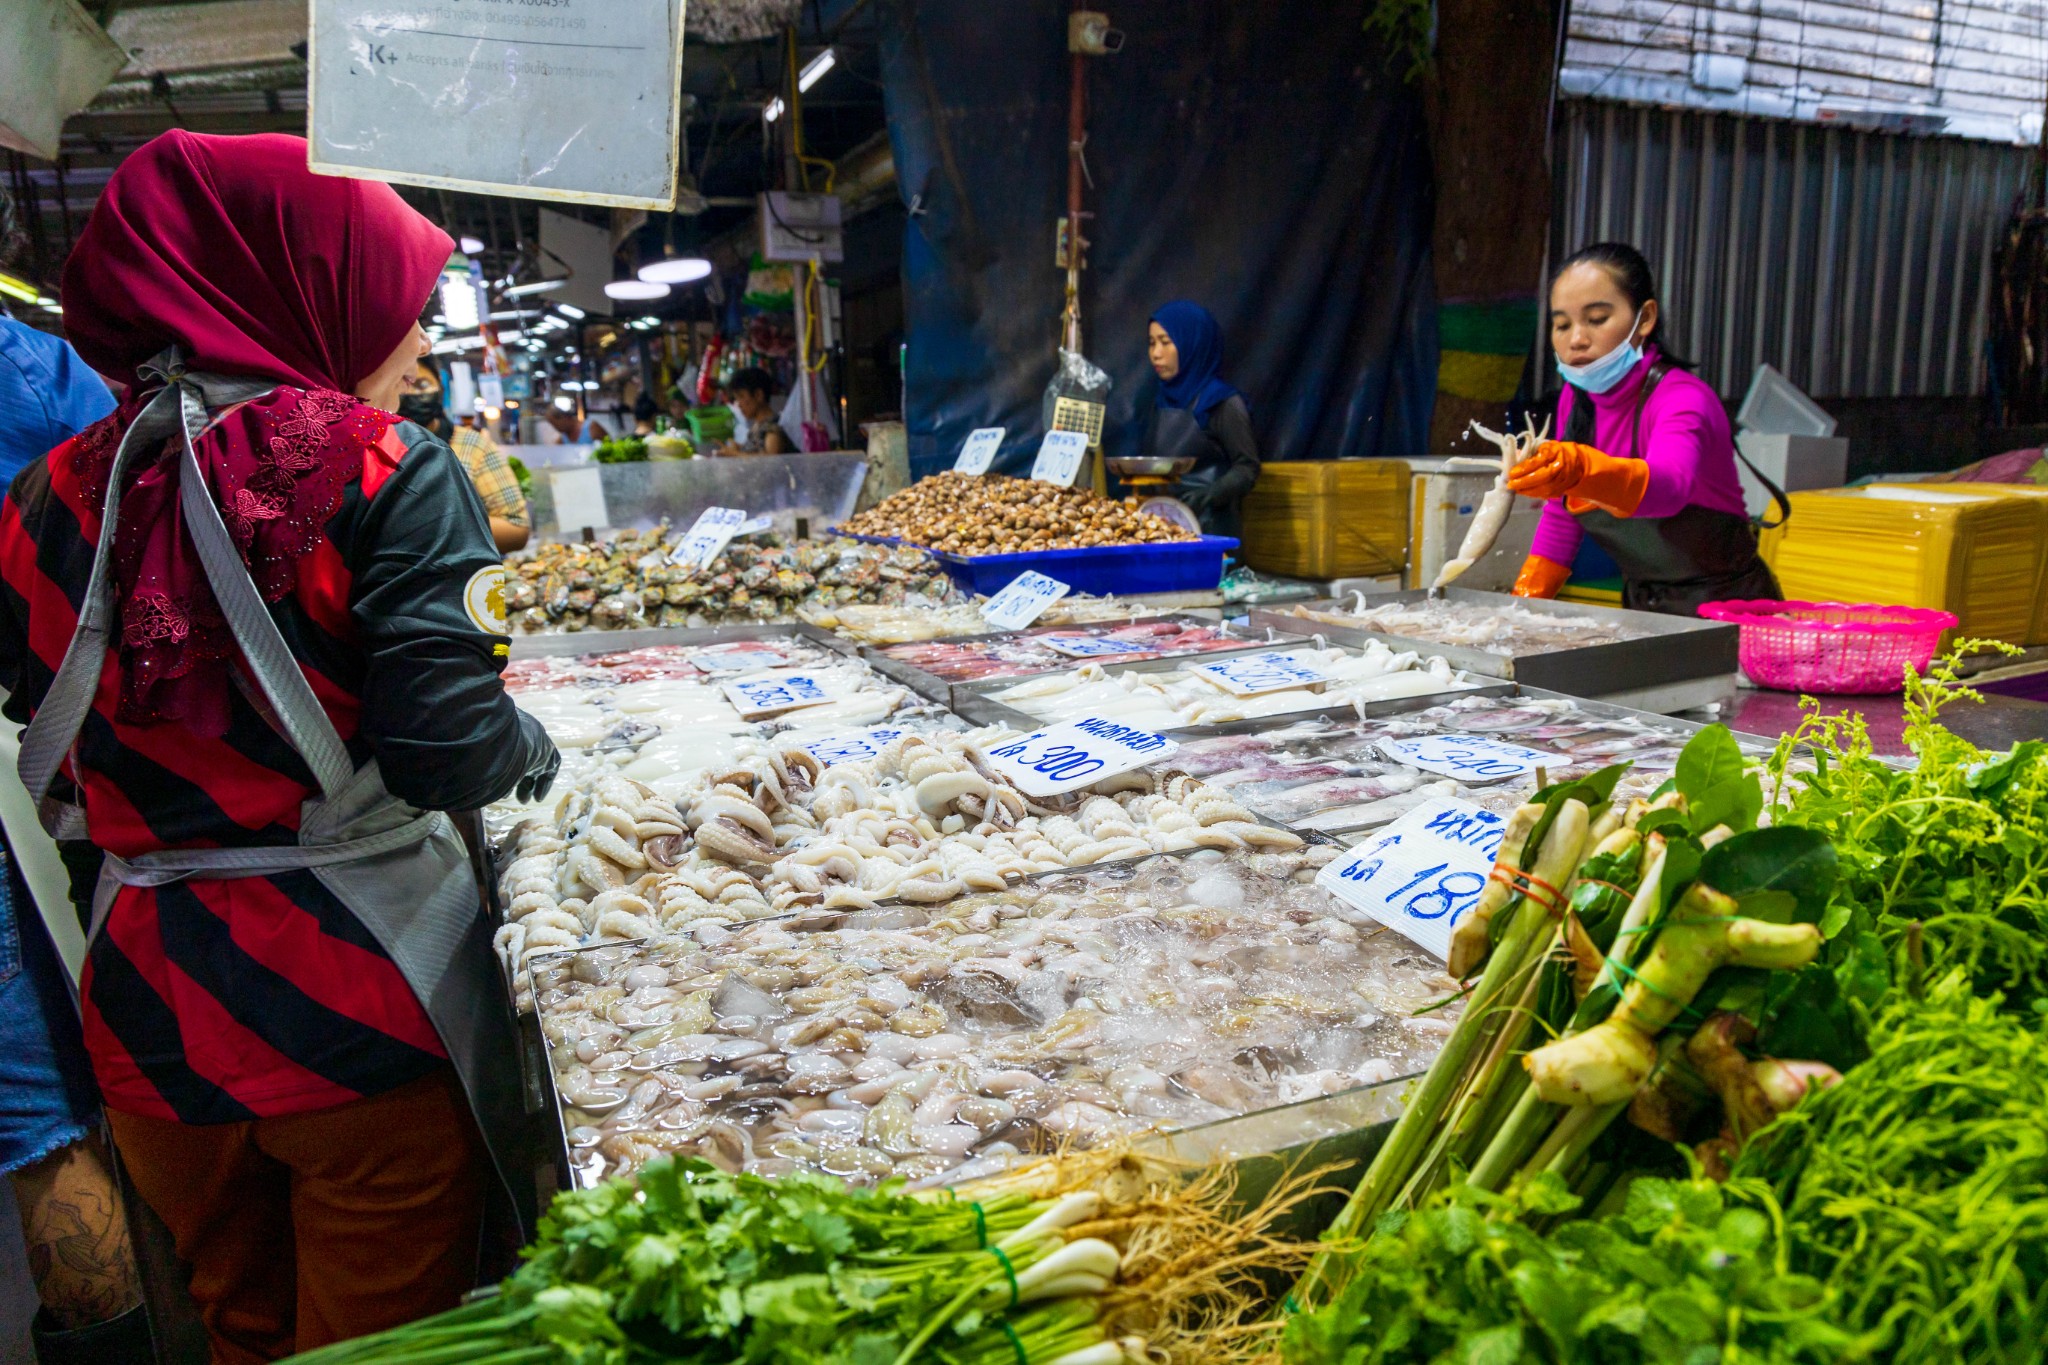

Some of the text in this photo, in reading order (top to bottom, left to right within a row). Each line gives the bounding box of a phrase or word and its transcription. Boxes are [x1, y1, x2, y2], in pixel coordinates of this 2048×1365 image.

[369, 43, 398, 65] K+
[406, 52, 449, 66] Accepts
[452, 56, 464, 69] all
[1017, 745, 1105, 781] 300
[1416, 749, 1525, 775] 340
